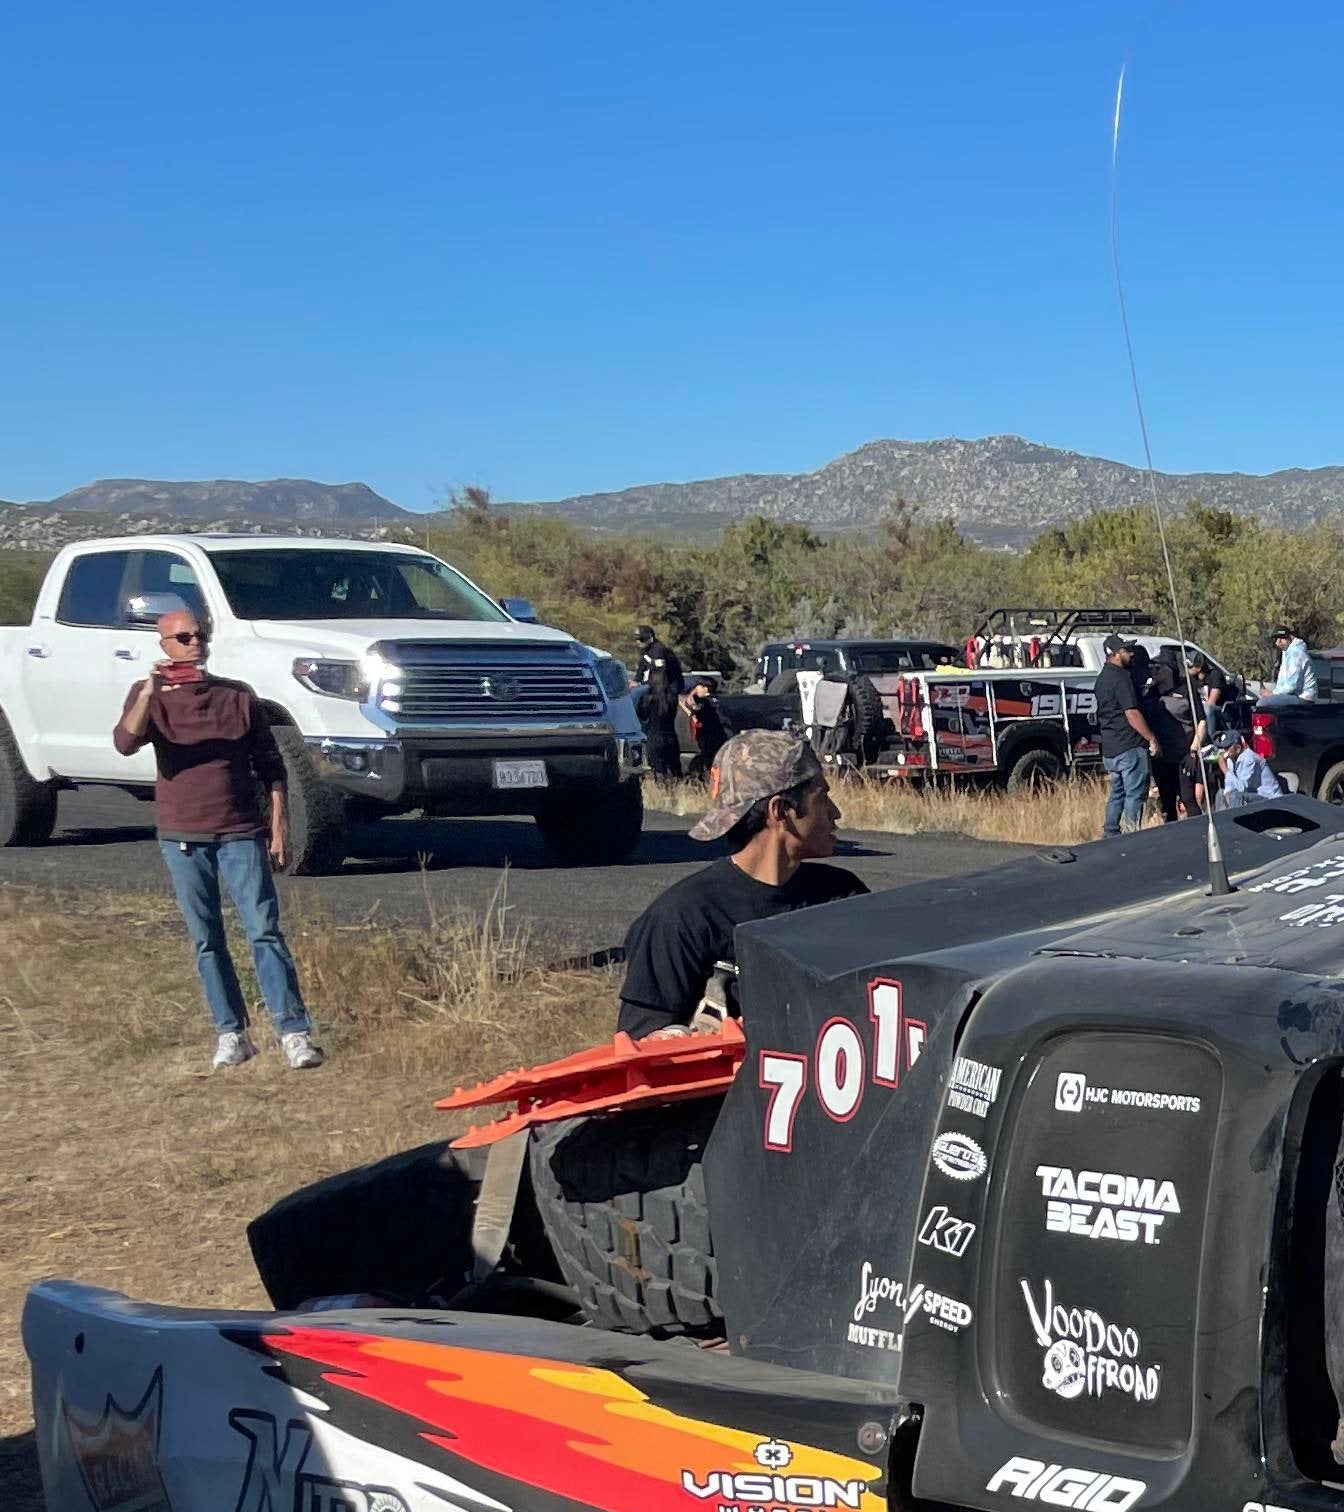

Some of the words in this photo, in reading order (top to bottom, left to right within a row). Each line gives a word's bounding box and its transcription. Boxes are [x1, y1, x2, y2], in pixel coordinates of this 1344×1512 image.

[1085, 1087, 1109, 1103] HJC
[1111, 1089, 1201, 1112] MOTORSPORTS
[1035, 1165, 1181, 1213] TACOMA
[919, 1206, 977, 1257] K1
[923, 1290, 973, 1326] SPEED
[681, 1469, 861, 1510] VISION
